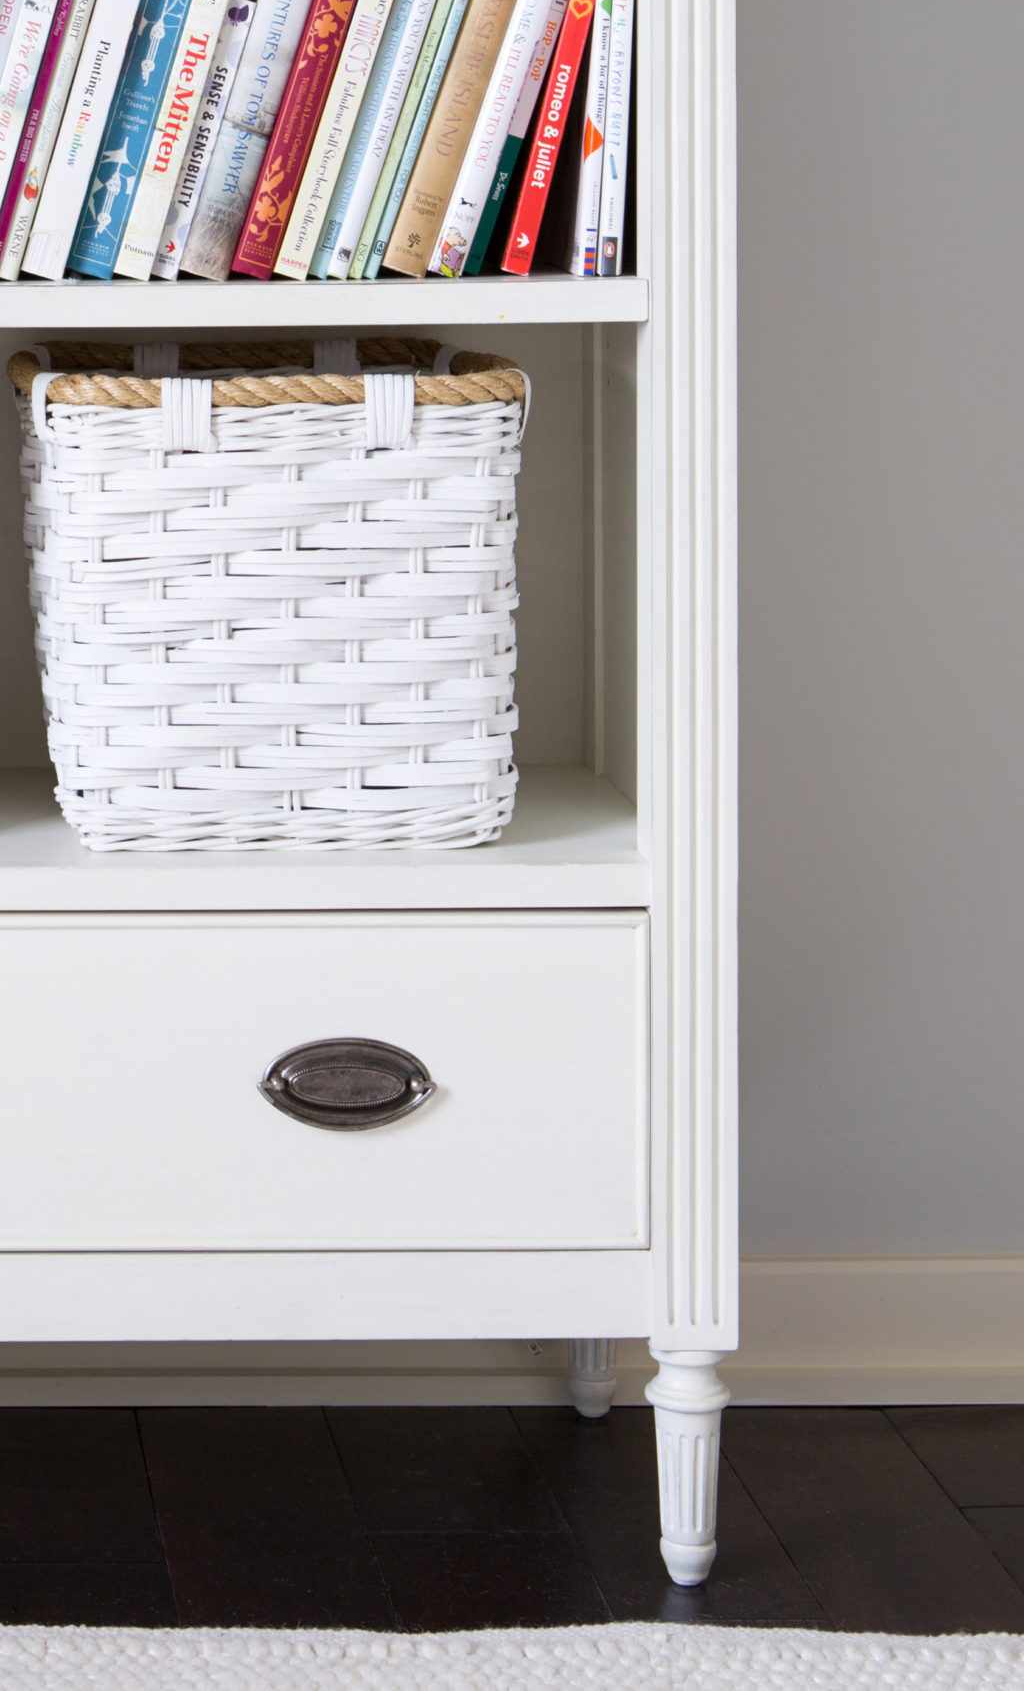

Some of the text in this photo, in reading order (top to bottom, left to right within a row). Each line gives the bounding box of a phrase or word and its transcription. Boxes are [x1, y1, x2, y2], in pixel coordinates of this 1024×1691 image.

[407, 17, 423, 42] YOU
[517, 10, 533, 31] ME
[18, 19, 41, 57] We're
[512, 32, 525, 45] &
[600, 27, 610, 51] know
[400, 44, 415, 65] DO
[504, 47, 522, 73] I'LL
[252, 64, 271, 88] OF
[599, 64, 607, 77] lot
[0, 60, 30, 108] Going
[389, 67, 407, 101] WITH
[491, 74, 513, 113] READ
[598, 79, 606, 90] of
[64, 39, 111, 169] Planting a Rainbow
[152, 30, 211, 175] The Mitten
[241, 90, 263, 127] TOM
[382, 103, 395, 121] AN
[593, 93, 605, 123] things
[0, 109, 13, 128] on
[433, 77, 475, 158] ISLAND
[483, 114, 500, 137] TO
[527, 63, 573, 189] romeo & juliet
[176, 65, 228, 207] SENSE & SENSIBILITY
[370, 123, 388, 158] IDEA?
[221, 129, 251, 195] SAWYER
[473, 137, 493, 169] YOU
[491, 171, 508, 201] Dr. Seuss
[411, 203, 435, 217] Ingpen
[414, 195, 439, 209] Robert
[8, 213, 28, 258] WARNE
[125, 243, 154, 257] Putnam
[280, 256, 307, 268] HARPER
[356, 242, 368, 261] FSG
